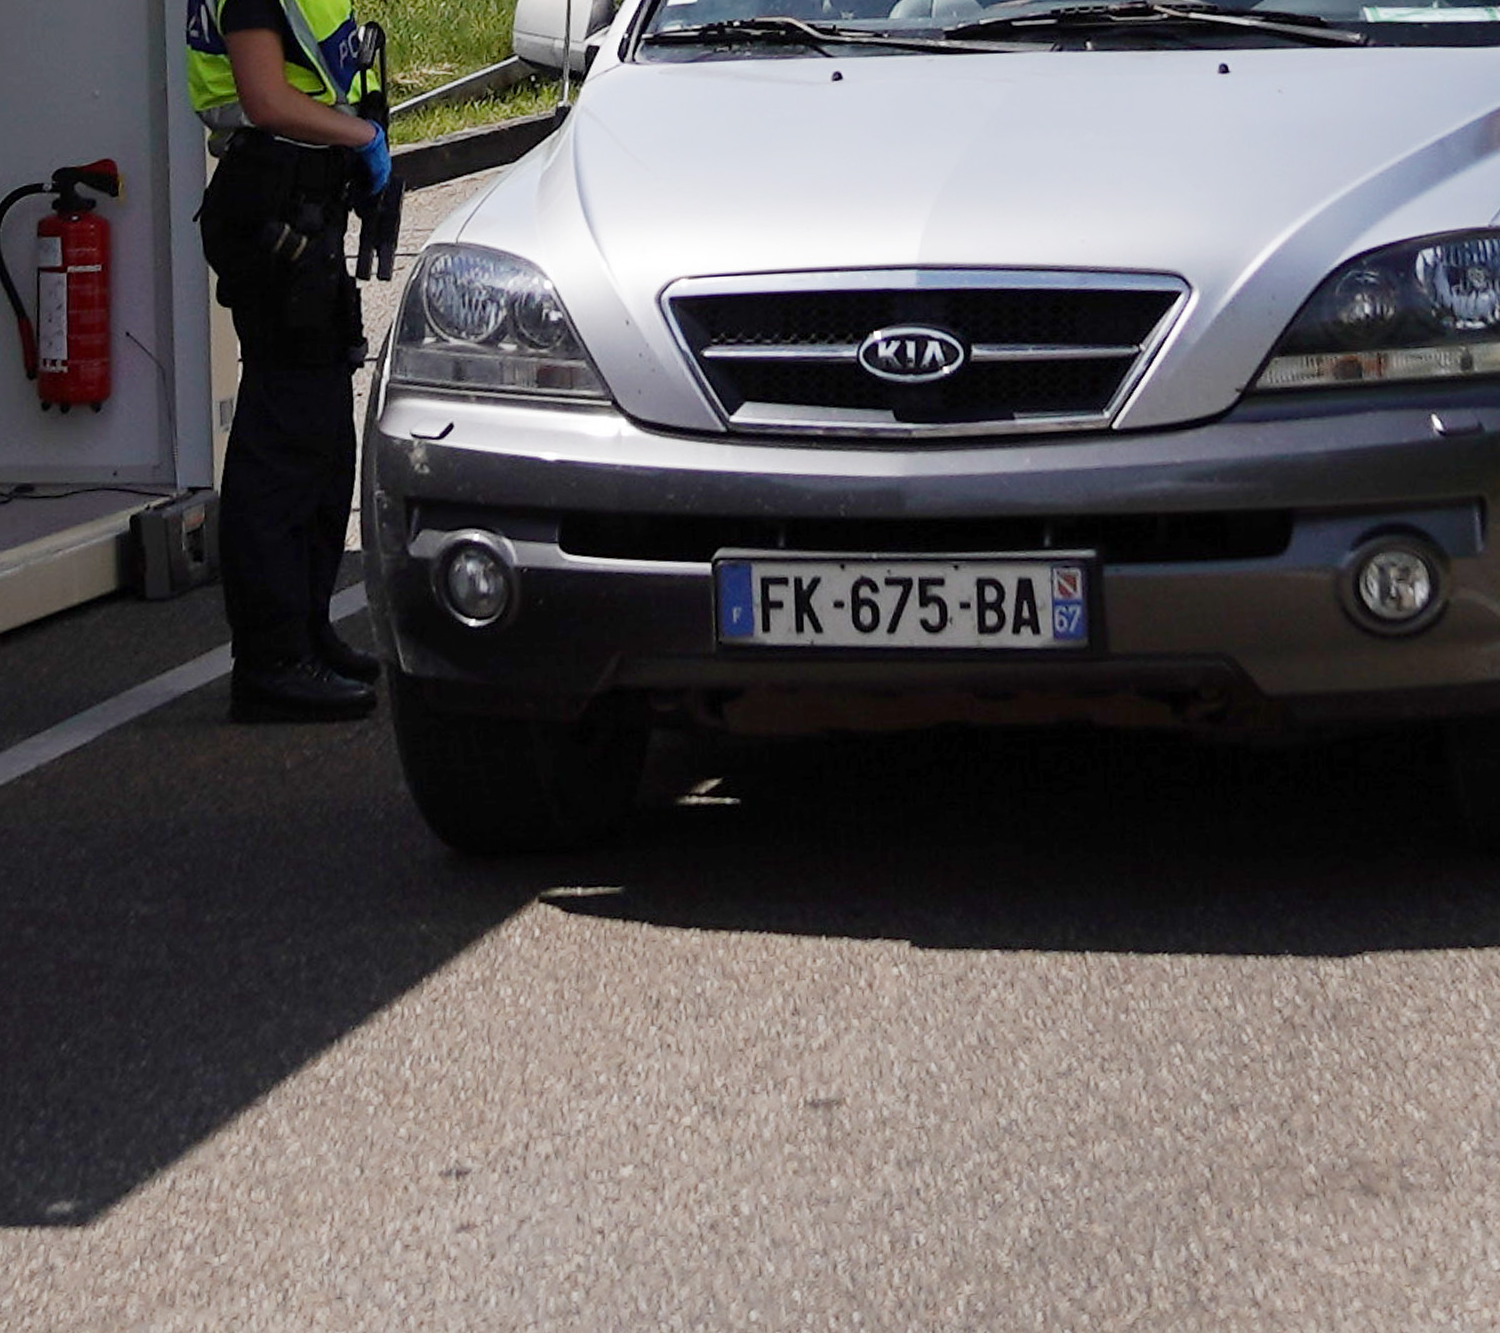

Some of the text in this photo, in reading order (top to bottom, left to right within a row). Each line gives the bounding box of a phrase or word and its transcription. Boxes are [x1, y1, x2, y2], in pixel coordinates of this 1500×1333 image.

[877, 339, 947, 369] KIA
[759, 575, 1042, 635] FK-675-BA
[1053, 604, 1082, 632] 67
